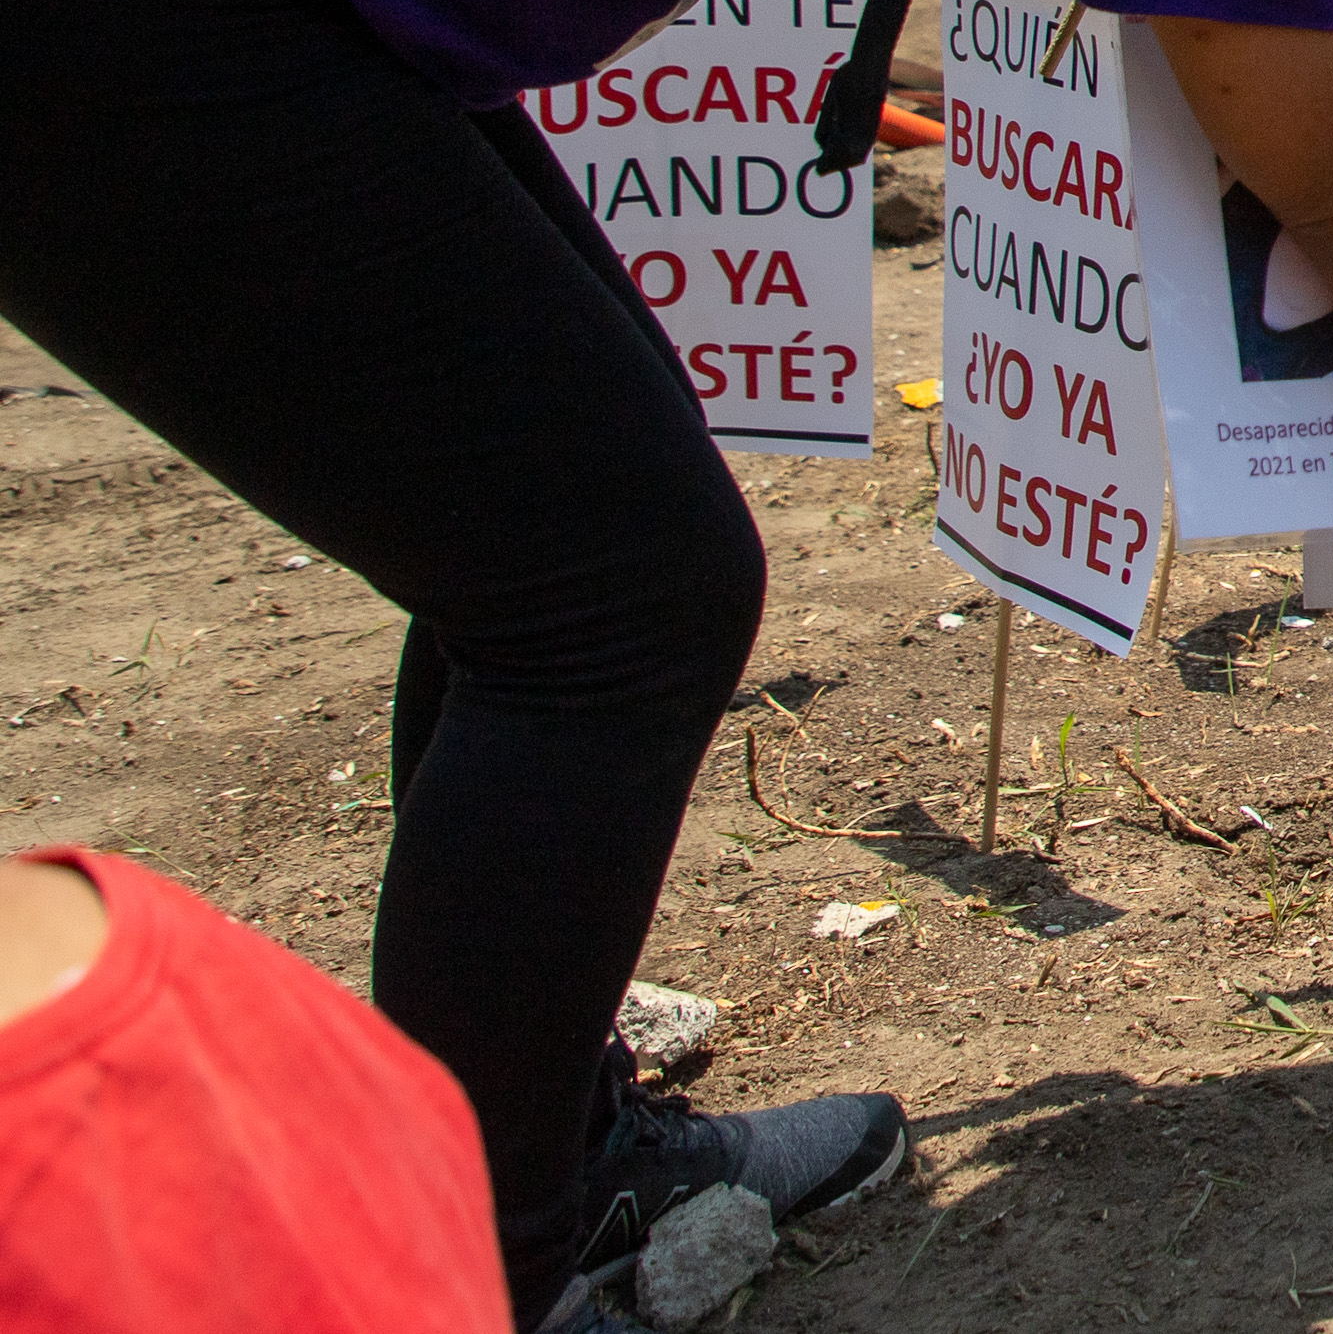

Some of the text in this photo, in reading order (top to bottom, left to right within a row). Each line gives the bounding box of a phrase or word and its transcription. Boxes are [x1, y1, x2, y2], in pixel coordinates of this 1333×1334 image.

[951, 97, 1134, 231] BUSCAR
[713, 249, 809, 308] YA
[680, 330, 859, 405] STÉ?
[965, 331, 1117, 457] ¿YO YA
[945, 422, 1149, 585] NO ESTÉ?
[1248, 456, 1297, 478] 2021
[1302, 457, 1326, 474] en
